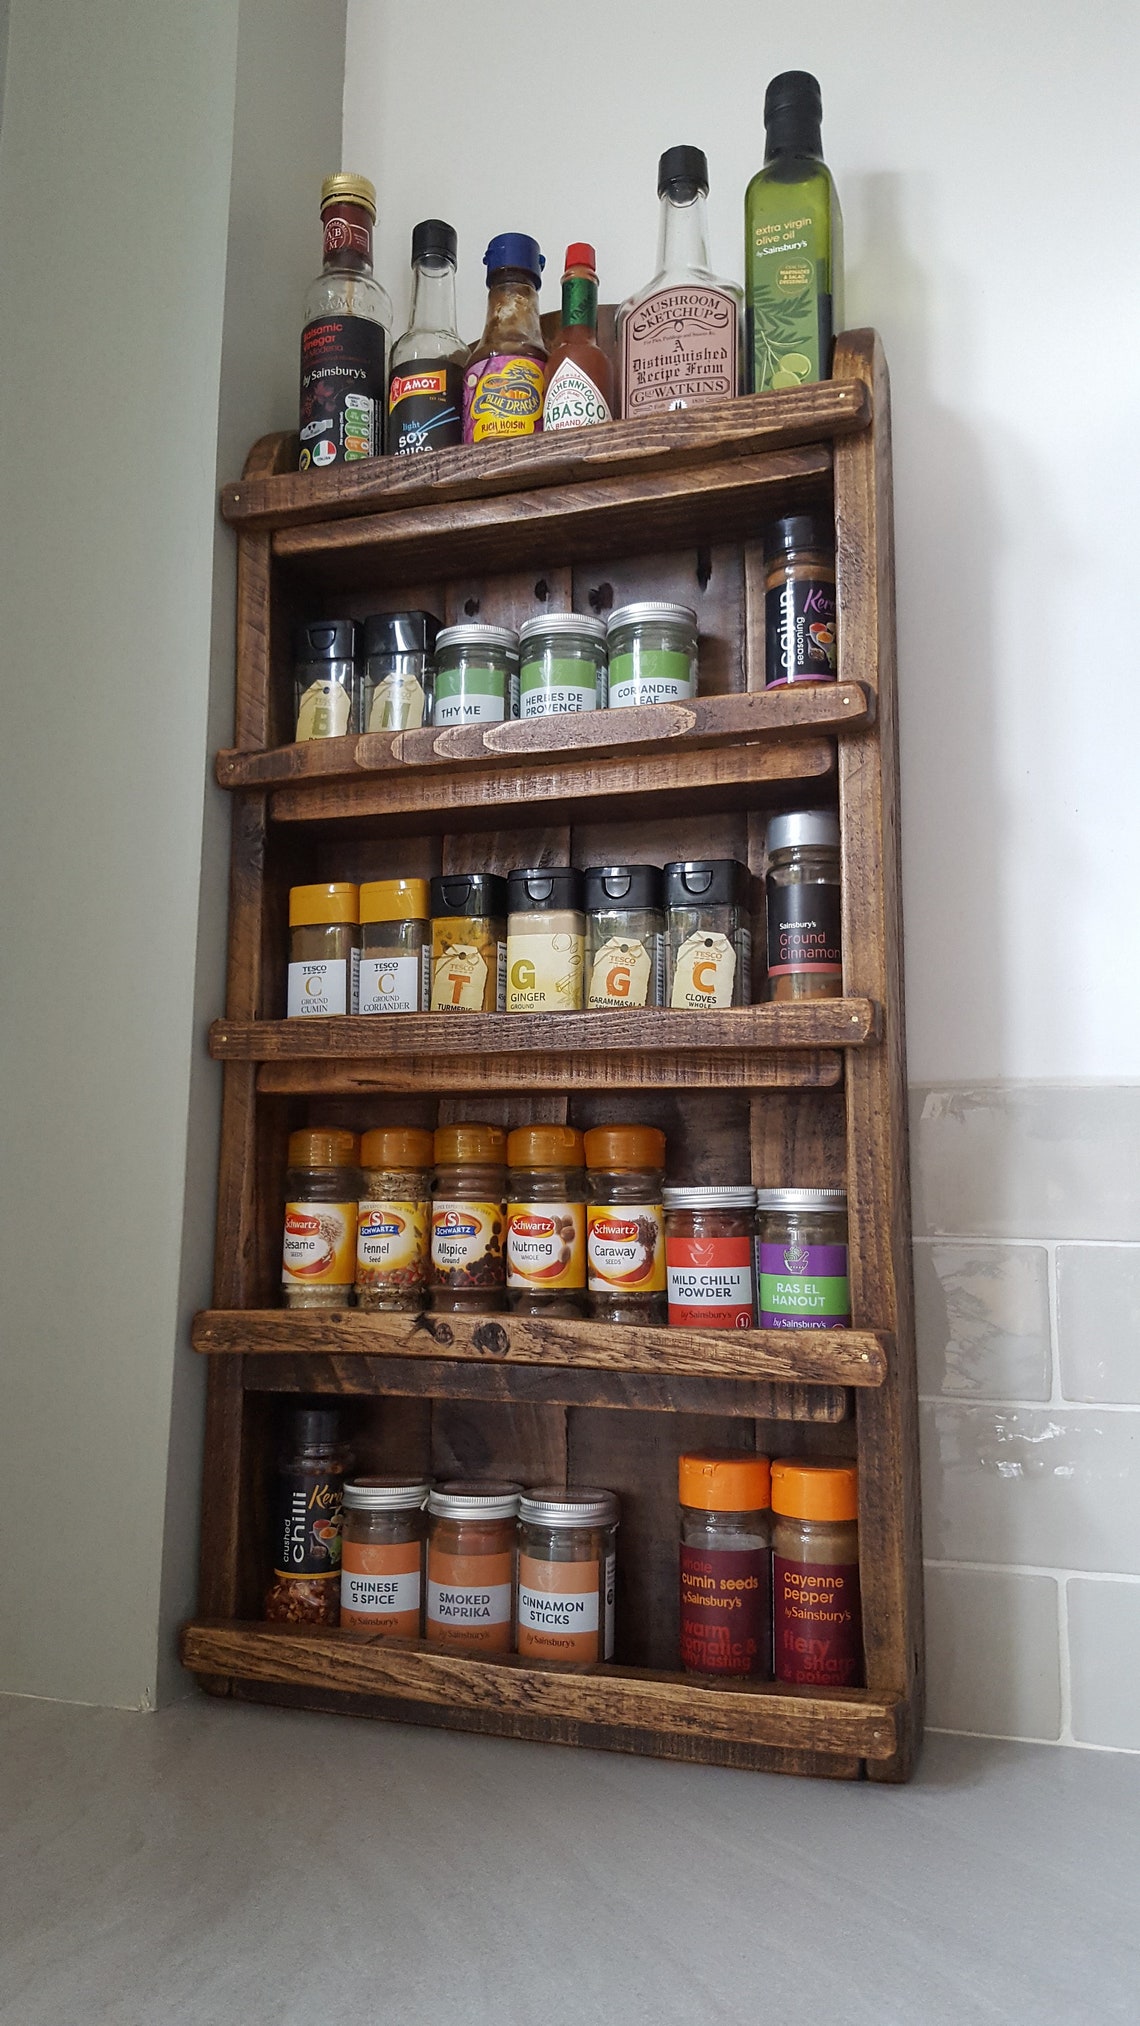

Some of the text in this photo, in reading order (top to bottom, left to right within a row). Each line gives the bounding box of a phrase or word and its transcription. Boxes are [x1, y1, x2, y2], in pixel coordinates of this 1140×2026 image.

[756, 218, 812, 236] extra virgin
[756, 230, 796, 246] olive oil
[762, 240, 808, 256] Sainsbury's
[640, 295, 721, 320] MUSHROOM
[646, 307, 714, 329] KETCHUP
[673, 339, 684, 353] A
[633, 347, 728, 373] Distinguished
[312, 366, 368, 381] Sainsbury's
[637, 362, 724, 384] Recipe From
[404, 378, 437, 392] AMOY
[654, 380, 724, 399] WATKINS
[486, 394, 505, 408] BLUE
[506, 395, 540, 412] DRAGON
[546, 402, 606, 424] ABASCO
[402, 420, 420, 432] light
[482, 421, 498, 432] RICH
[500, 420, 526, 430] HOISIN
[556, 420, 581, 430] BRAND
[398, 432, 429, 448] soy
[796, 616, 806, 666] seasoning
[568, 692, 583, 703] DE
[618, 684, 678, 698] CORANDER
[441, 706, 481, 719] THYME
[526, 703, 583, 717] PROVENCE
[780, 921, 817, 930] Sainsbury's
[780, 932, 826, 946] Ground
[610, 955, 636, 964] TESCO
[695, 951, 723, 960] TESCO
[780, 948, 840, 960] Cinnamon
[302, 964, 327, 972] TESCO
[374, 962, 398, 970] TESCO
[450, 964, 474, 972] TESCO
[510, 959, 536, 991] G
[606, 966, 631, 997] G
[692, 962, 717, 994] C
[305, 976, 322, 997] C
[378, 973, 395, 994] C
[448, 974, 471, 1004] T
[372, 994, 400, 1002] GROUND
[510, 992, 546, 1002] GINGER
[590, 996, 614, 1005] GARAM
[686, 994, 717, 1004] CLOVES
[301, 1004, 328, 1014] CUMIN
[364, 1002, 410, 1012] CORIANDER
[286, 1218, 318, 1230] Schwartz
[372, 1212, 381, 1226] S
[448, 1213, 457, 1227] S
[513, 1220, 552, 1231] Schwartz
[361, 1226, 395, 1236] SCHWARTZ
[436, 1226, 471, 1236] SCHWARTZ
[594, 1224, 635, 1235] Schwartz
[285, 1238, 316, 1250] Sesame
[364, 1242, 390, 1254] Fennel
[438, 1242, 468, 1256] Allspice
[512, 1241, 553, 1255] Nutmeg
[594, 1245, 637, 1260] Caraway
[672, 1275, 740, 1286] MILD CHILLI
[678, 1288, 732, 1298] POWDER
[776, 1283, 820, 1294] RAS EL
[772, 1296, 826, 1308] HANOUT
[680, 1310, 732, 1320] by Sainsbury's
[772, 1317, 827, 1328] by Sainsbury's
[292, 1492, 306, 1564] chilli
[283, 1519, 291, 1563] crushed
[350, 1580, 399, 1592] CHINESE
[682, 1572, 759, 1591] cumin seeds
[784, 1571, 845, 1588] cayenne
[352, 1594, 395, 1605] 5 SPICE
[439, 1592, 490, 1605] SMOKED
[686, 1590, 742, 1610] Sainsbury's
[784, 1586, 834, 1606] pepper
[522, 1595, 584, 1612] CINNAMON
[439, 1604, 490, 1618] PAPRIKA
[530, 1610, 570, 1625] STICKS
[784, 1606, 852, 1624] by Sainsbury's
[357, 1616, 399, 1626] Sainsbury's
[447, 1630, 490, 1641] Sainsbury's
[526, 1632, 576, 1648] by Sainsbury's
